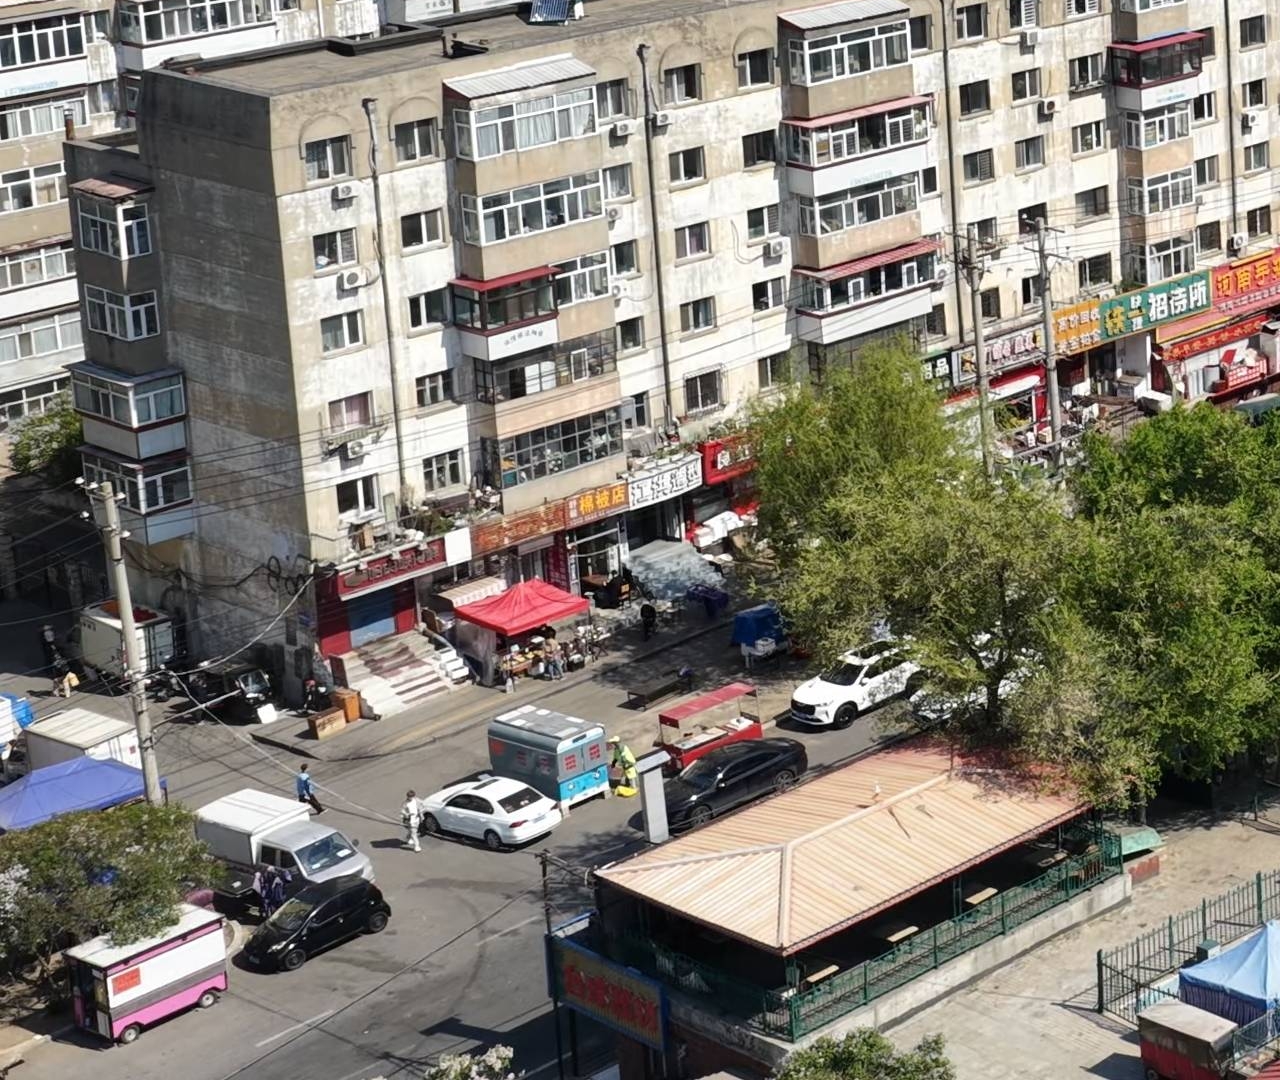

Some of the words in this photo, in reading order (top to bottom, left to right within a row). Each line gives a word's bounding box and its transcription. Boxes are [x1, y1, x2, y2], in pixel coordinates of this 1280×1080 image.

[1148, 283, 1207, 318] 招待所
[579, 485, 626, 515] 棉被店
